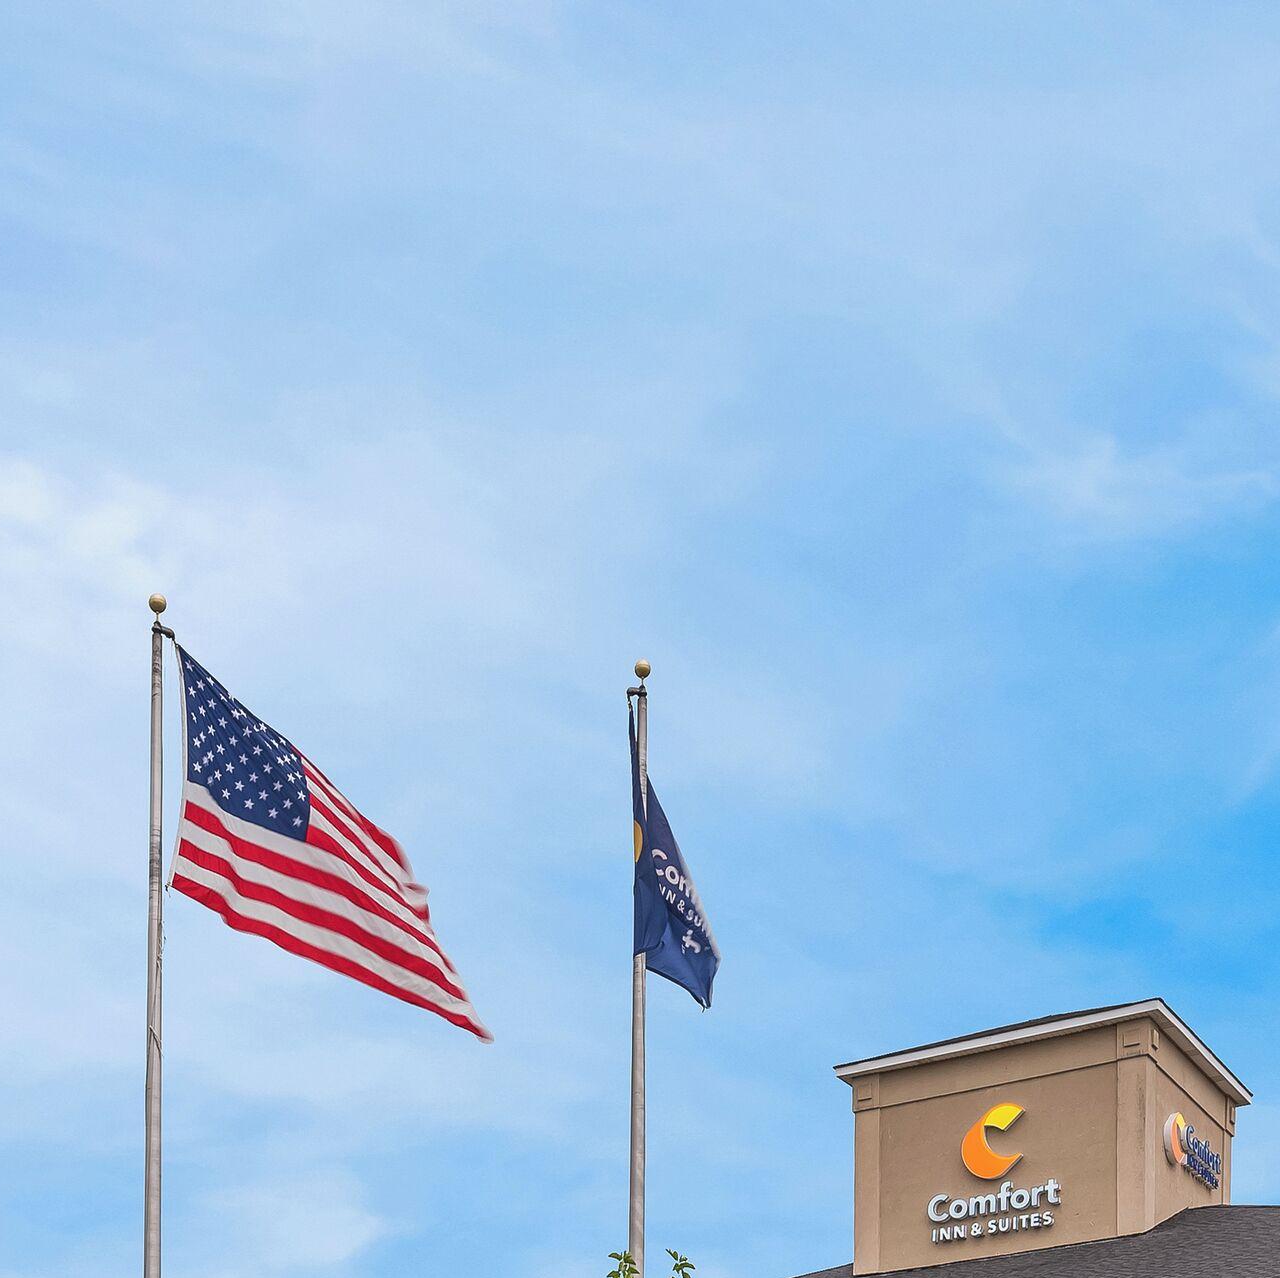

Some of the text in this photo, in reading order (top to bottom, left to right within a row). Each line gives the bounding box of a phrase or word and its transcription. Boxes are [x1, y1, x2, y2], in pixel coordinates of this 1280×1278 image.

[927, 1178, 1061, 1223] Comfort
[931, 1211, 1055, 1243] INN & SUITES
